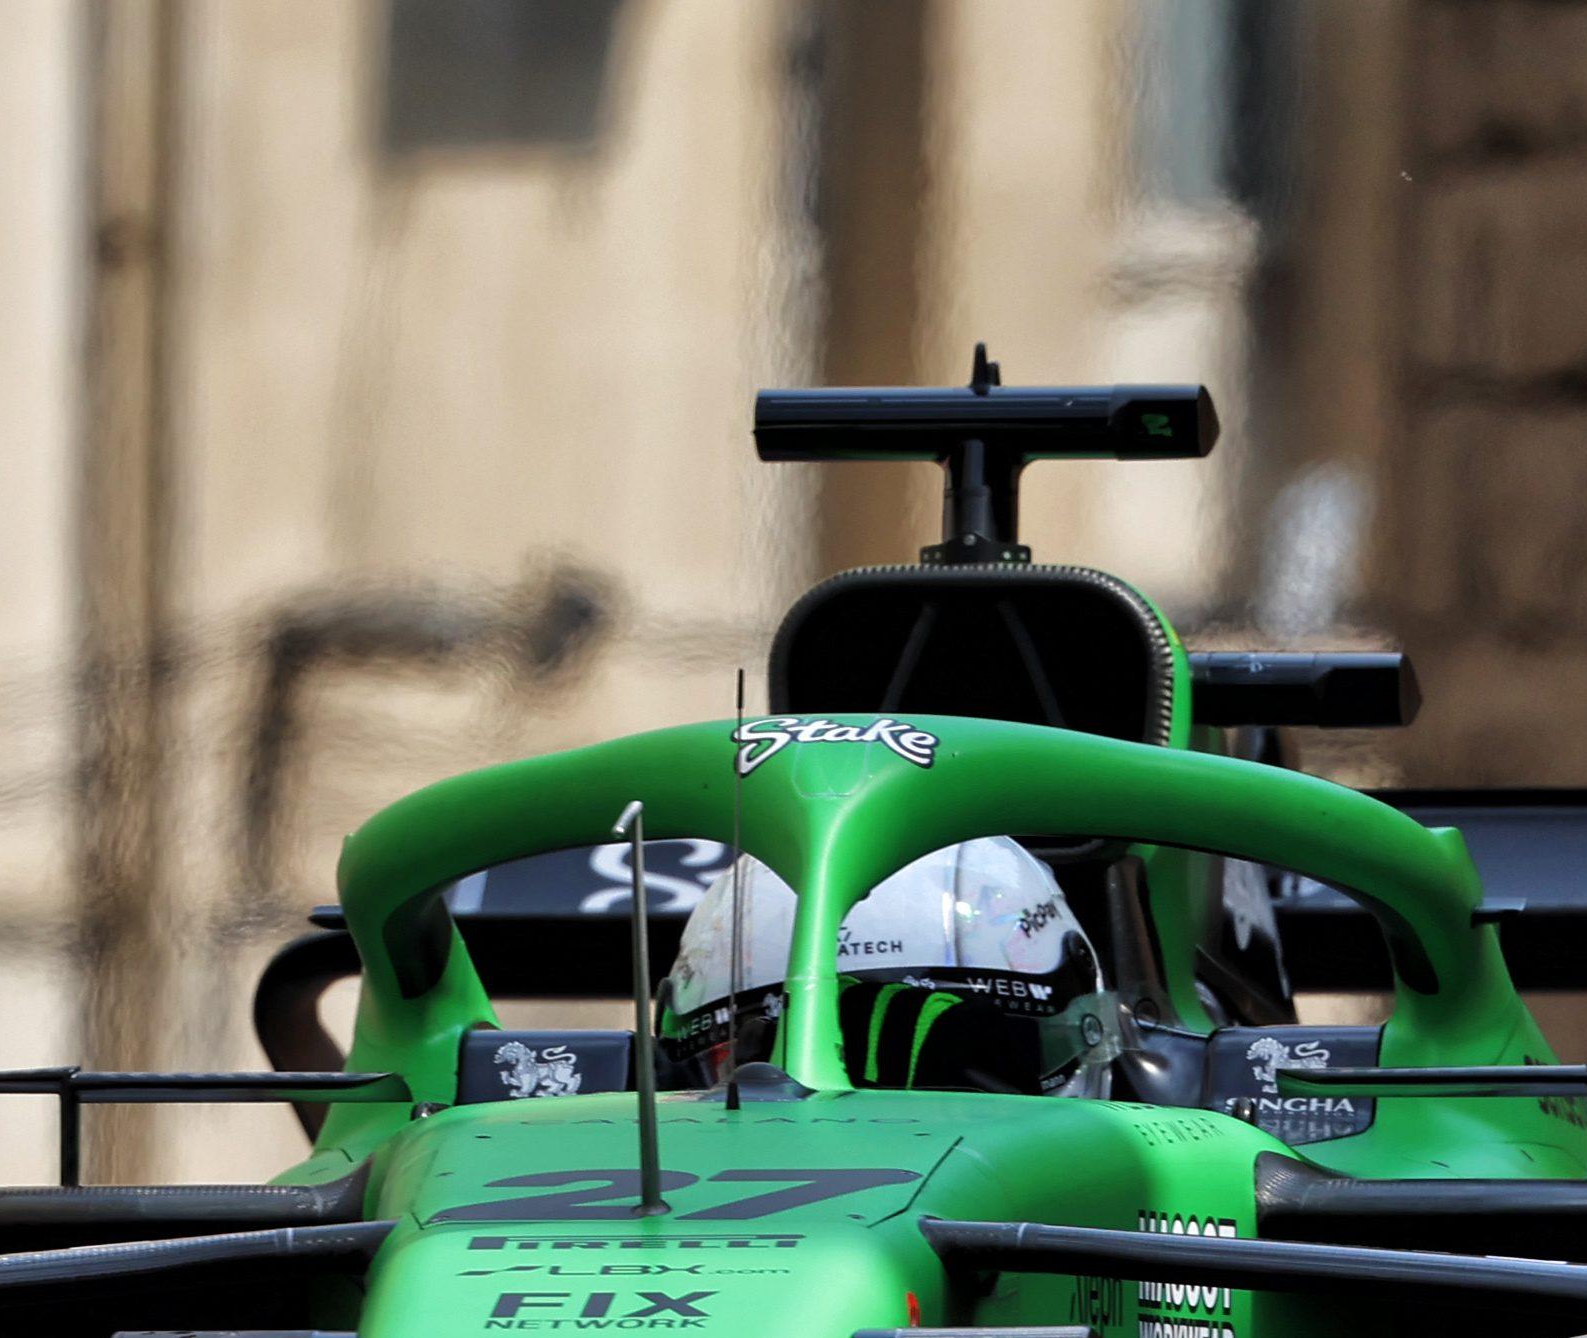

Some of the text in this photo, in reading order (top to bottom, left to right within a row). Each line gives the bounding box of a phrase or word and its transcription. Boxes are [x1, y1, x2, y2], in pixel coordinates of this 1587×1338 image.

[732, 717, 939, 777] Stake
[837, 940, 903, 956] ATECH
[1225, 1097, 1355, 1112] SNGHA
[520, 1116, 920, 1125] CAALANO
[421, 1169, 923, 1220] 27
[467, 1234, 807, 1251] PIRELLI
[490, 1291, 720, 1319] FIX
[483, 1318, 710, 1330] NETWORK
